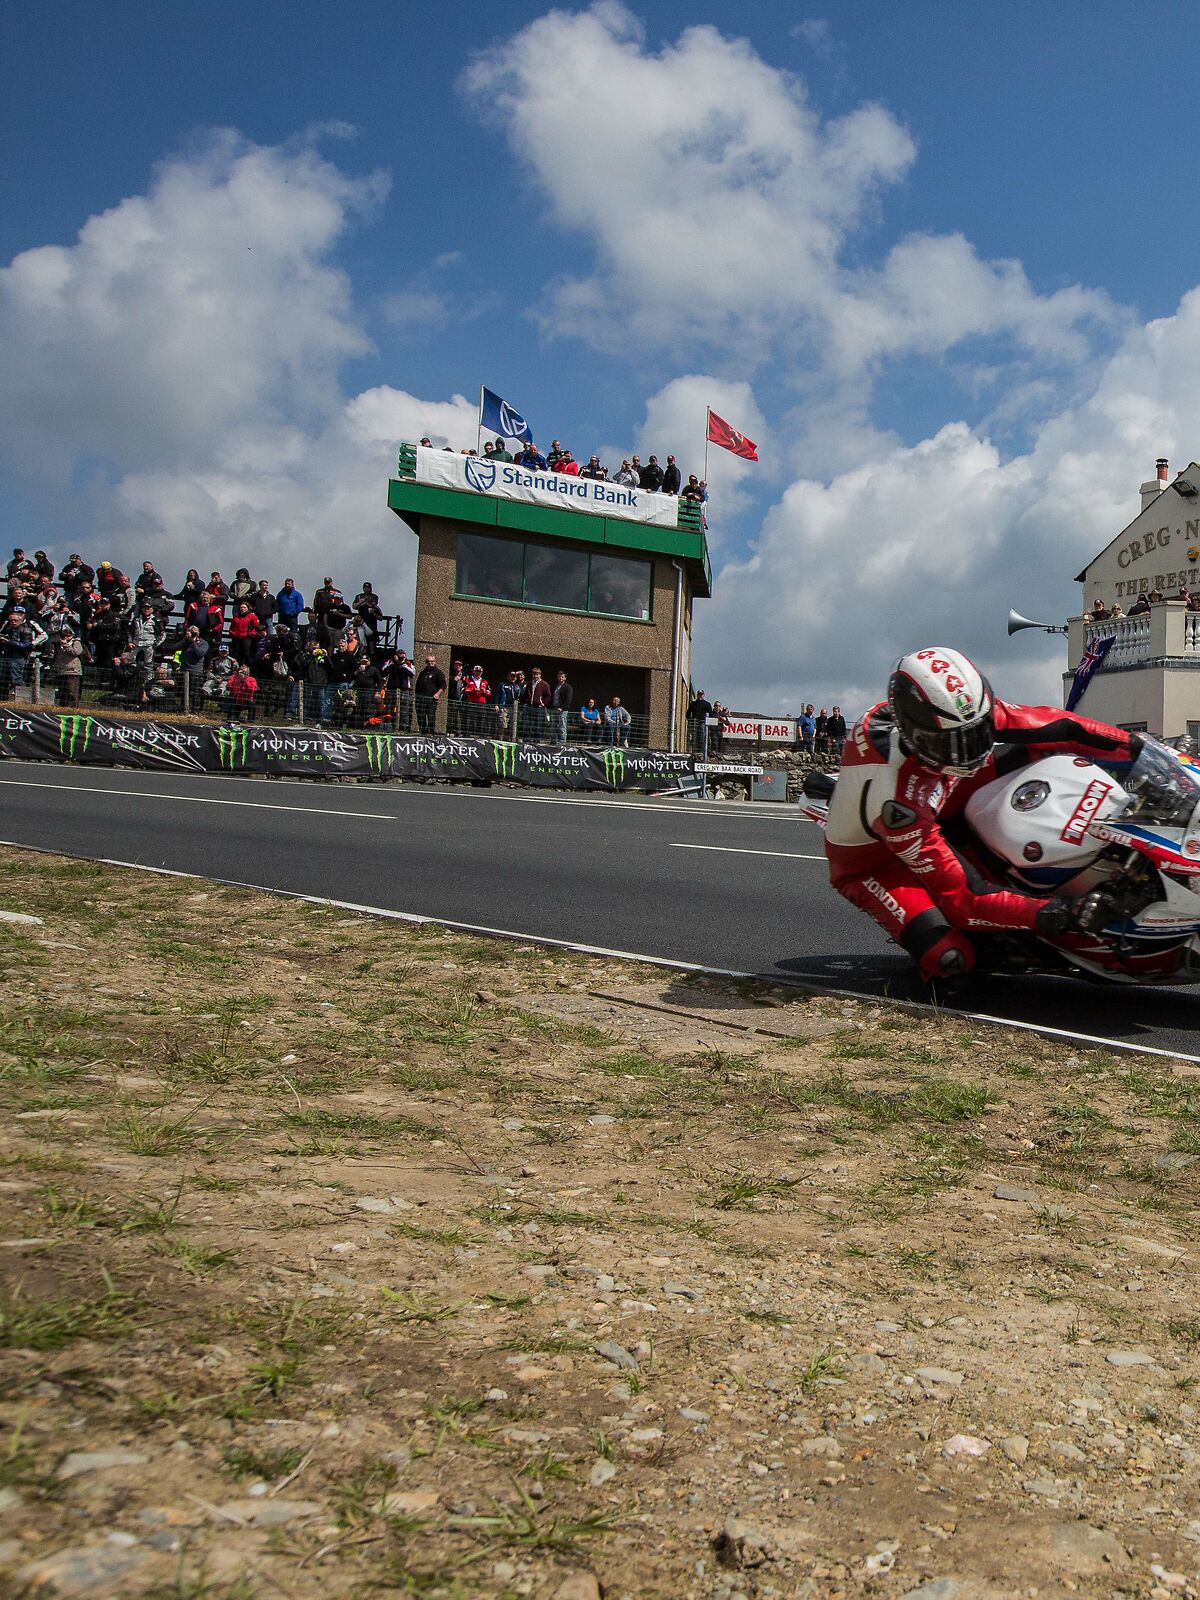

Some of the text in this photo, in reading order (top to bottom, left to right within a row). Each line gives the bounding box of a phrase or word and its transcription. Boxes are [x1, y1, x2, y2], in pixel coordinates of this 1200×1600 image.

[502, 467, 638, 507] Standard Bank
[1117, 526, 1171, 569] CREG
[1115, 577, 1149, 598] THE
[96, 727, 202, 749] MONSTER
[722, 723, 789, 737] SNACK BAR
[252, 738, 347, 753] MONSTER
[396, 741, 480, 758] MONSTER
[410, 757, 468, 765] ENERGY
[518, 751, 590, 768] MONSTER
[627, 759, 690, 771] MONSTER
[530, 766, 580, 775] ENERGY
[1063, 781, 1110, 840] MOTUL
